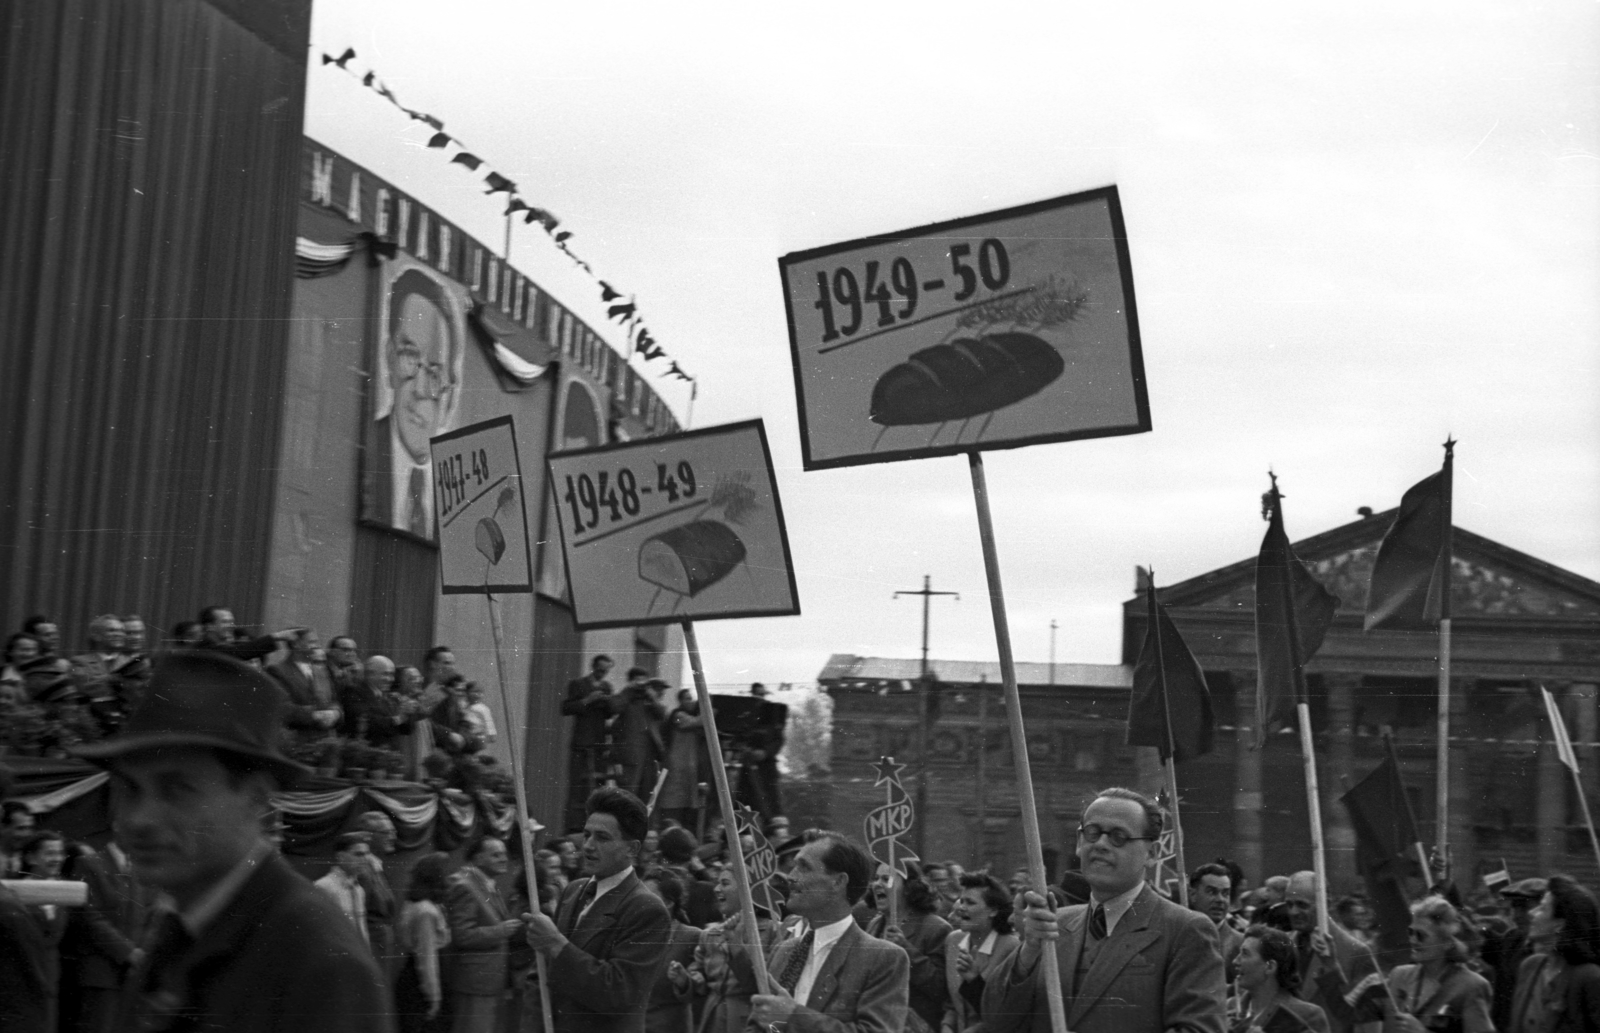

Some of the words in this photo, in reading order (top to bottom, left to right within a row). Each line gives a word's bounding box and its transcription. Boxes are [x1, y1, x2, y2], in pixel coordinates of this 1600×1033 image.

[815, 237, 1010, 342] 1949-50
[438, 448, 489, 517] 1947-48
[565, 460, 697, 535] 1948-49
[869, 804, 911, 838] MKP
